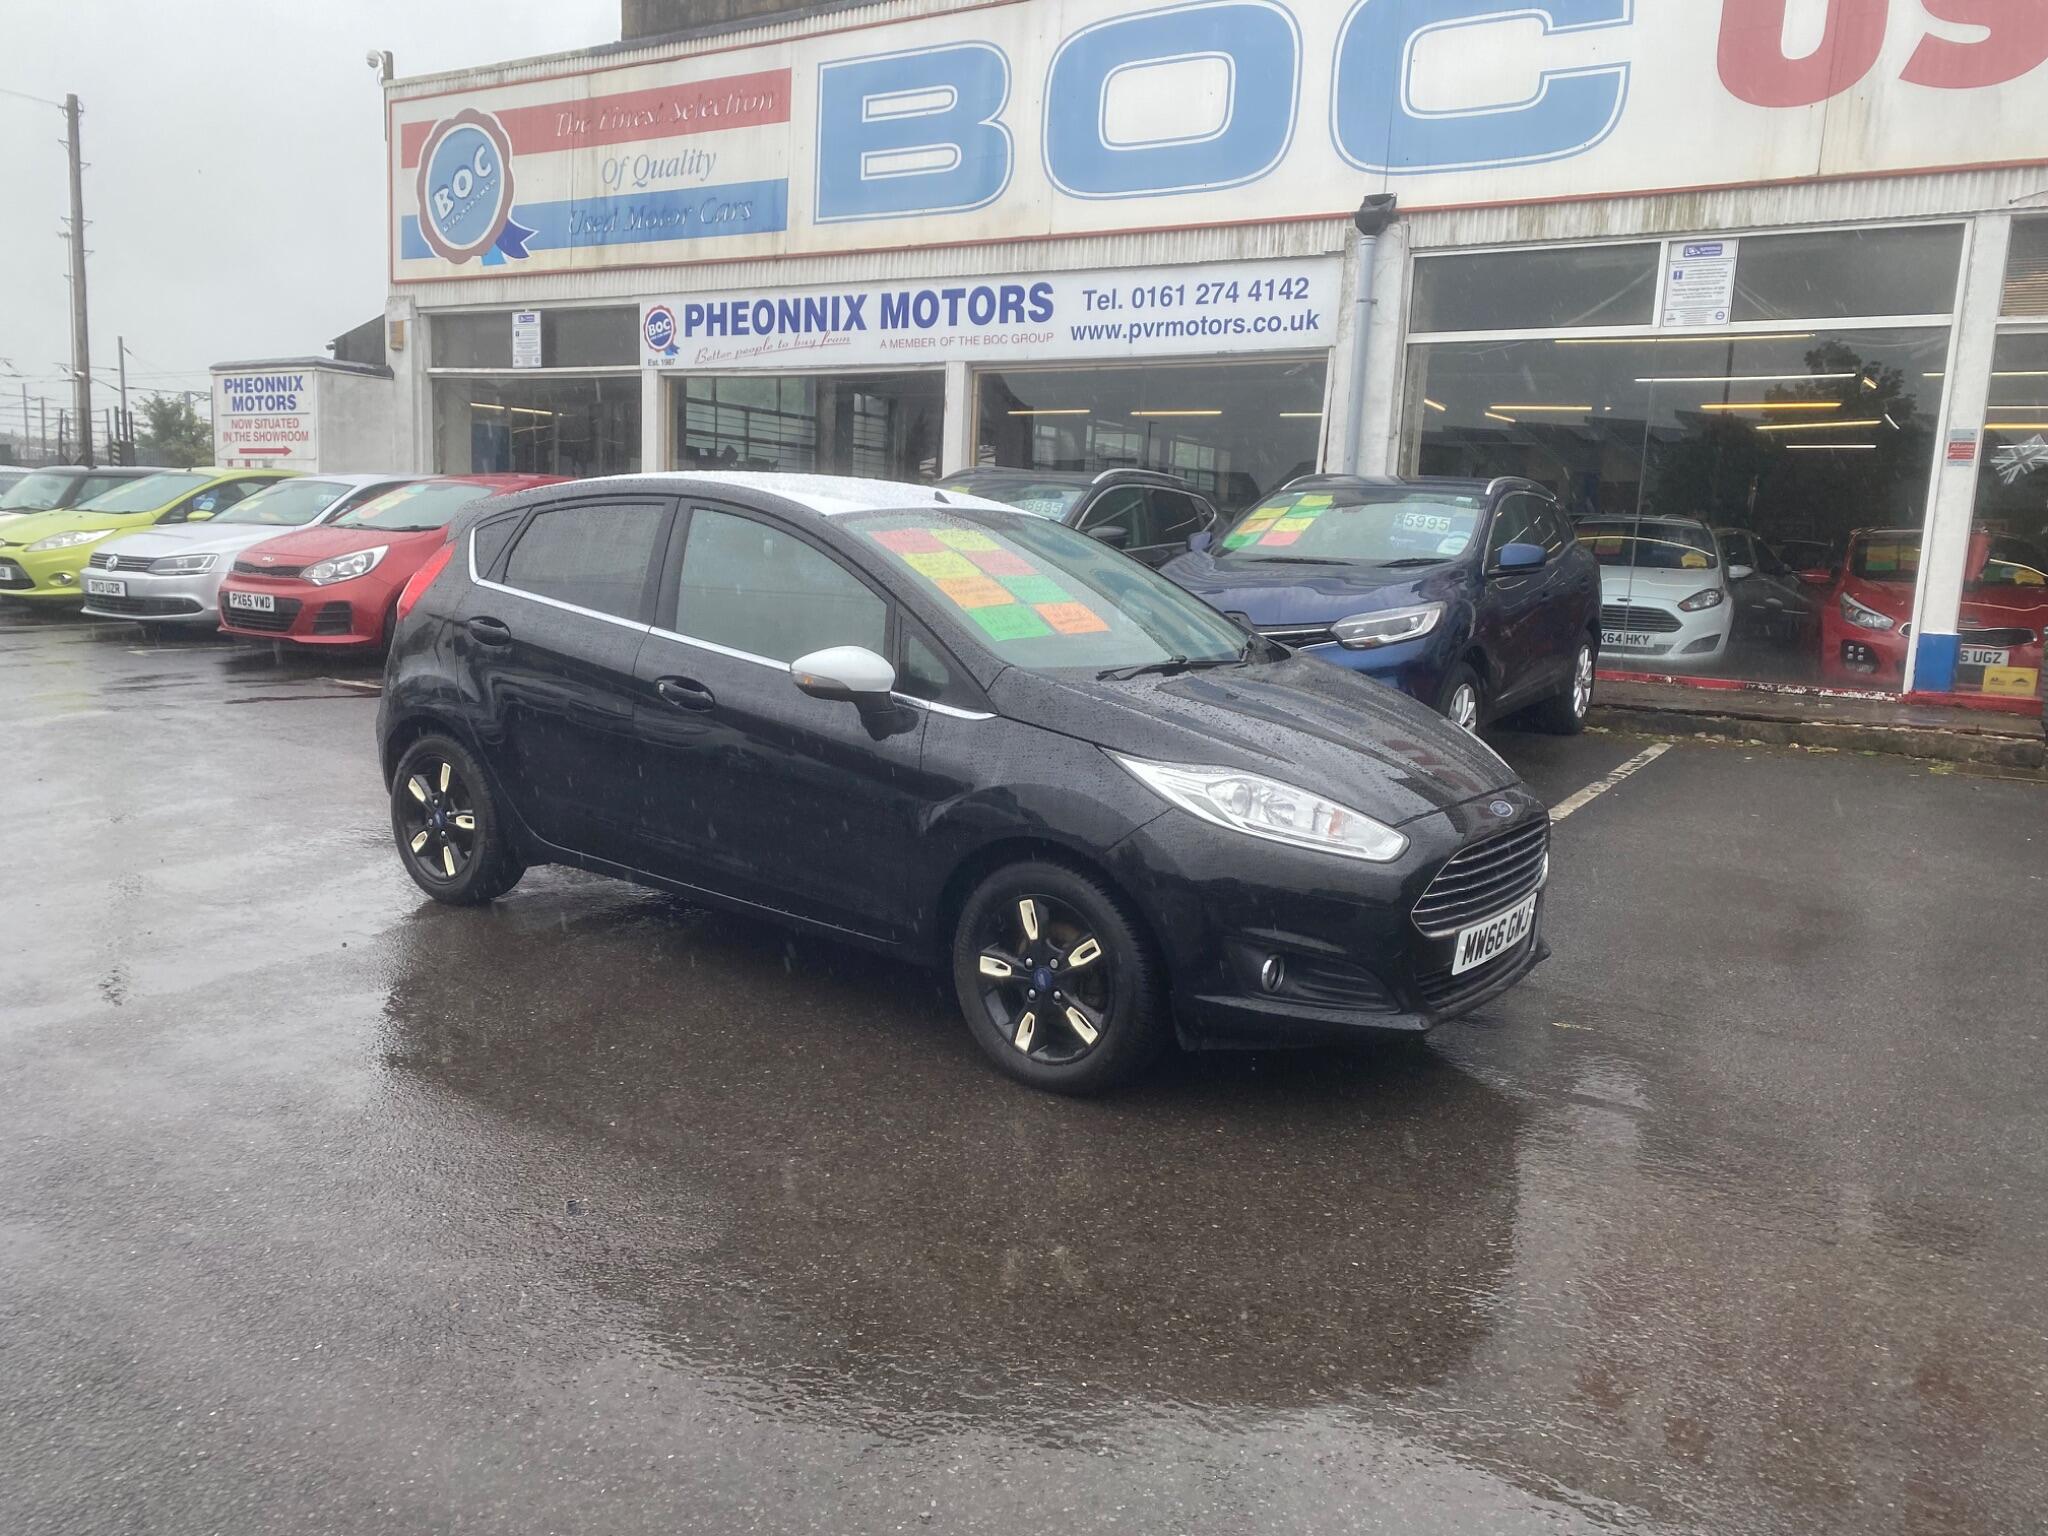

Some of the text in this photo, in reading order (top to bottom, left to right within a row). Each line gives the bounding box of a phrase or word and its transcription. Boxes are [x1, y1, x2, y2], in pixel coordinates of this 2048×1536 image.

[556, 111, 592, 137] The
[669, 89, 775, 122] Selection
[814, 0, 1635, 225] BOC
[433, 143, 493, 220] BOC
[602, 148, 717, 191] Of Quality
[567, 196, 753, 236] Used Motor Cars
[684, 281, 1055, 338] PHEONNIX MOTORS
[1082, 276, 1310, 312] Tel. 0161 274 4142
[648, 318, 671, 336] BOC
[879, 331, 1055, 350] A MEMBER OF THE BOC GROUP
[1070, 308, 1321, 344] www.pvrmotors.co.uk
[694, 330, 851, 365] Better people to buy from
[223, 375, 304, 394] PHEONNIX
[231, 394, 297, 412] MOTORS
[222, 430, 309, 443] IN THE SHOWROOM
[230, 417, 300, 430] NOW SITUATED
[232, 592, 271, 609] PX65 VWD
[1625, 633, 1650, 646] HKY
[1973, 650, 2003, 664] UGZ
[1462, 918, 1507, 966] MW66
